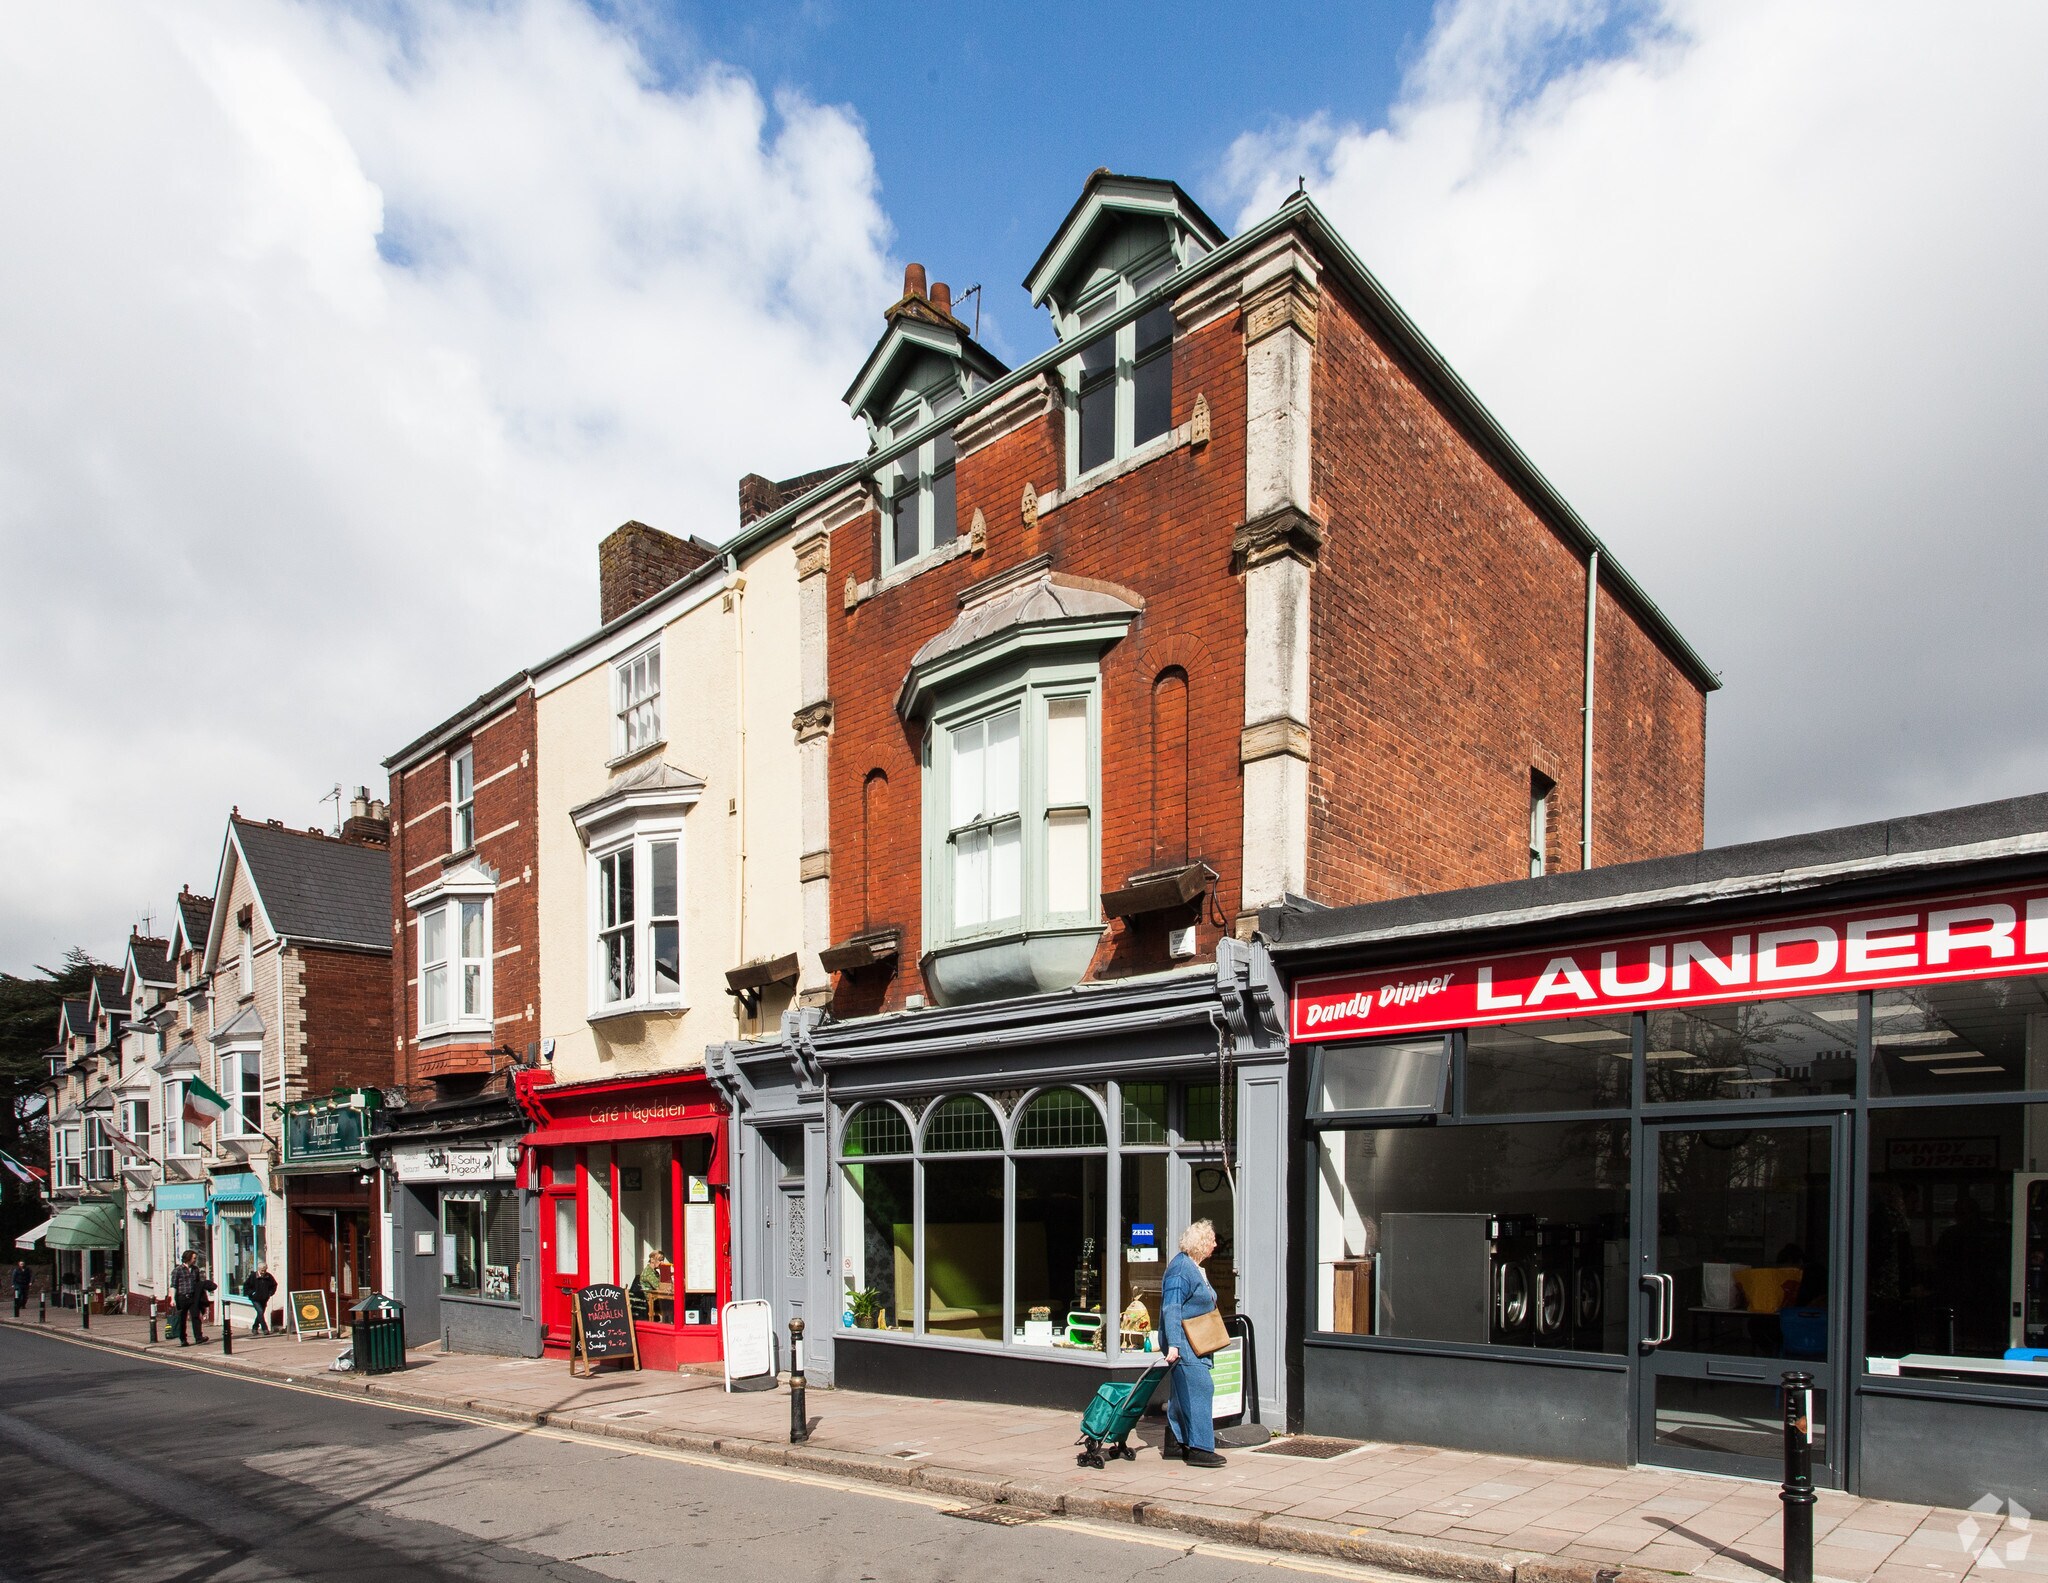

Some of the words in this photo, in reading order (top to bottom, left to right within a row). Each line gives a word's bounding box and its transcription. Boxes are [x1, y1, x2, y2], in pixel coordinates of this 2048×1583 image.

[1477, 900, 2048, 1011] LAUNDER
[1306, 992, 1373, 1027] Dandy
[1378, 973, 1455, 1008] Dipper
[590, 1106, 618, 1123] Café
[624, 1096, 685, 1124] Magdalen
[1892, 1142, 1967, 1155] DANDY
[457, 1154, 481, 1166] Salty
[1911, 1154, 1993, 1167] DIPPER
[451, 1164, 481, 1177] Pigeon
[583, 1288, 621, 1302] WELCOME
[587, 1309, 624, 1321] MAGDALEN
[588, 1341, 607, 1352] Sunday
